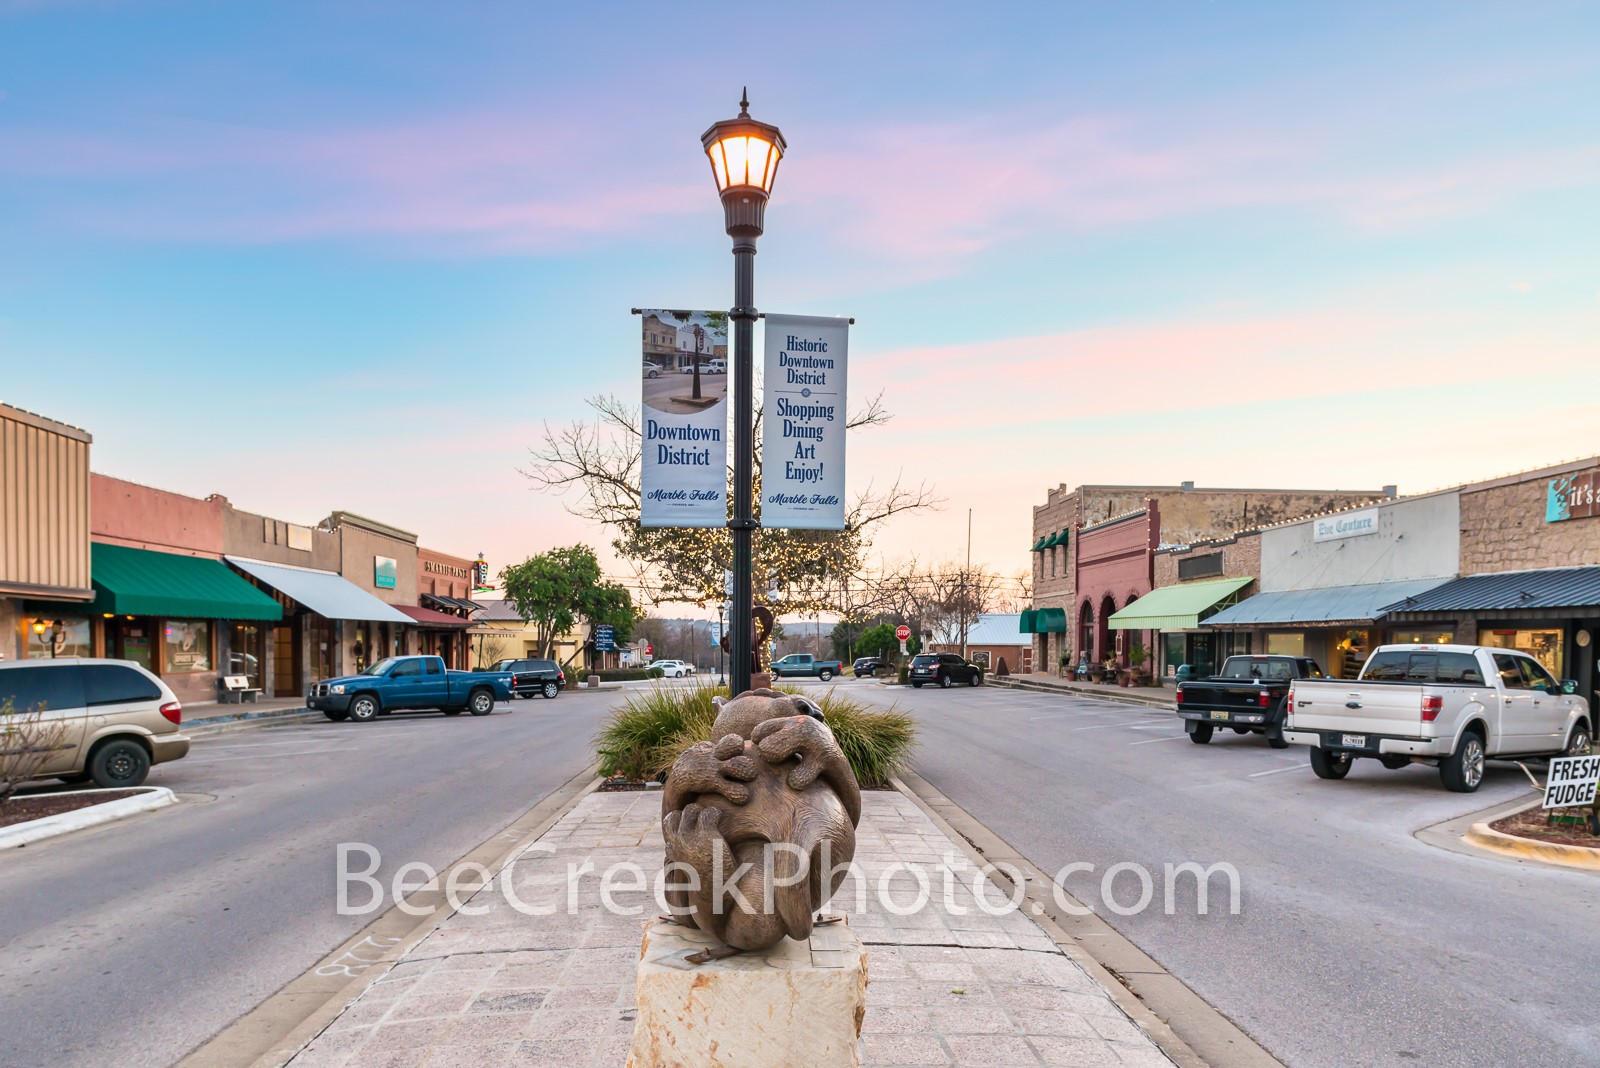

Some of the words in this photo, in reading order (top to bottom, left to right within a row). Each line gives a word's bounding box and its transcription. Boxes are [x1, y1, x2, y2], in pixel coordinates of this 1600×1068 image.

[787, 335, 828, 352] Historic
[779, 351, 834, 369] Downtown
[787, 368, 826, 385] District
[777, 397, 834, 421] Shopping
[647, 419, 721, 441] Downtown
[783, 419, 824, 442] Dining
[658, 444, 710, 466] District
[794, 440, 815, 459] Art
[785, 461, 824, 483] Enjoy!
[647, 489, 688, 502] Marble
[689, 489, 719, 501] Falls
[768, 493, 808, 505] Marble
[810, 493, 839, 505] Falls
[1570, 484, 1594, 506] it's
[1551, 758, 1600, 781] FRESH
[1545, 782, 1596, 806] FUDGE
